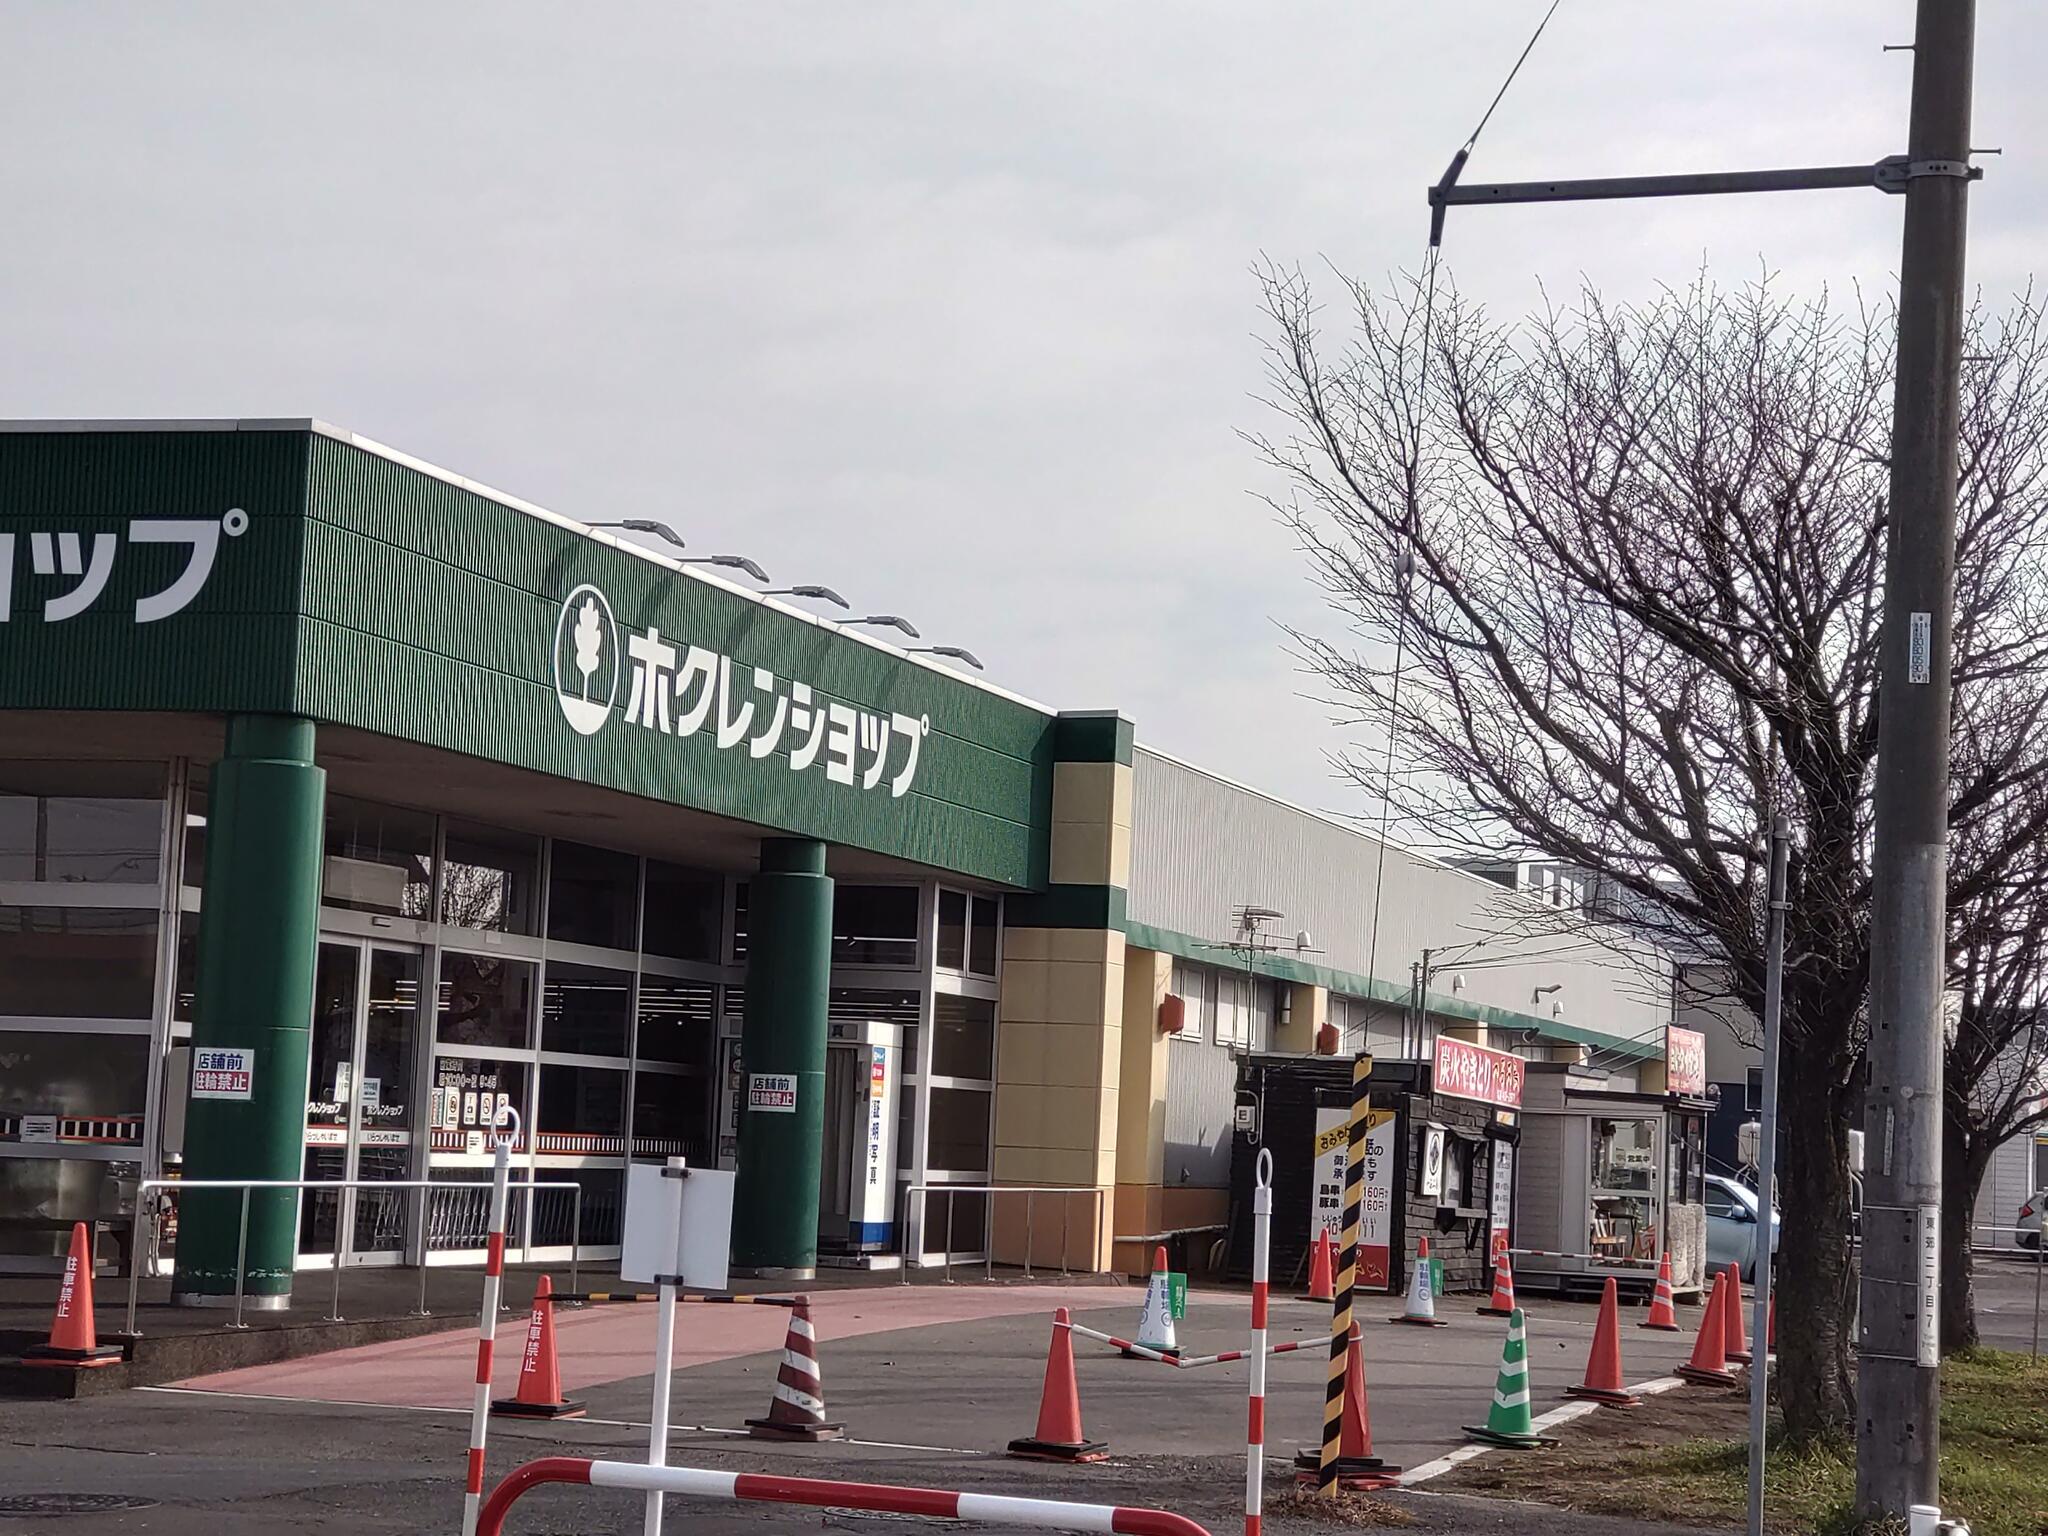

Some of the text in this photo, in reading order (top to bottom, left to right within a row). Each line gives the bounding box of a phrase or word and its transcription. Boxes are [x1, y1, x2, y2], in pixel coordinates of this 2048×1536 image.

[624, 627, 929, 797] ホクレンショップ
[196, 1072, 247, 1090] 駐輪禁止
[198, 1053, 243, 1070] 店舗前
[753, 1077, 789, 1091] 店舗前
[1439, 1044, 1491, 1099] 炭火やきとり
[752, 1091, 793, 1105] 駐輪禁止
[869, 1099, 881, 1185] 証明写真
[56, 1256, 78, 1318] 駐車禁止
[523, 1310, 544, 1373] 駐車禁止
